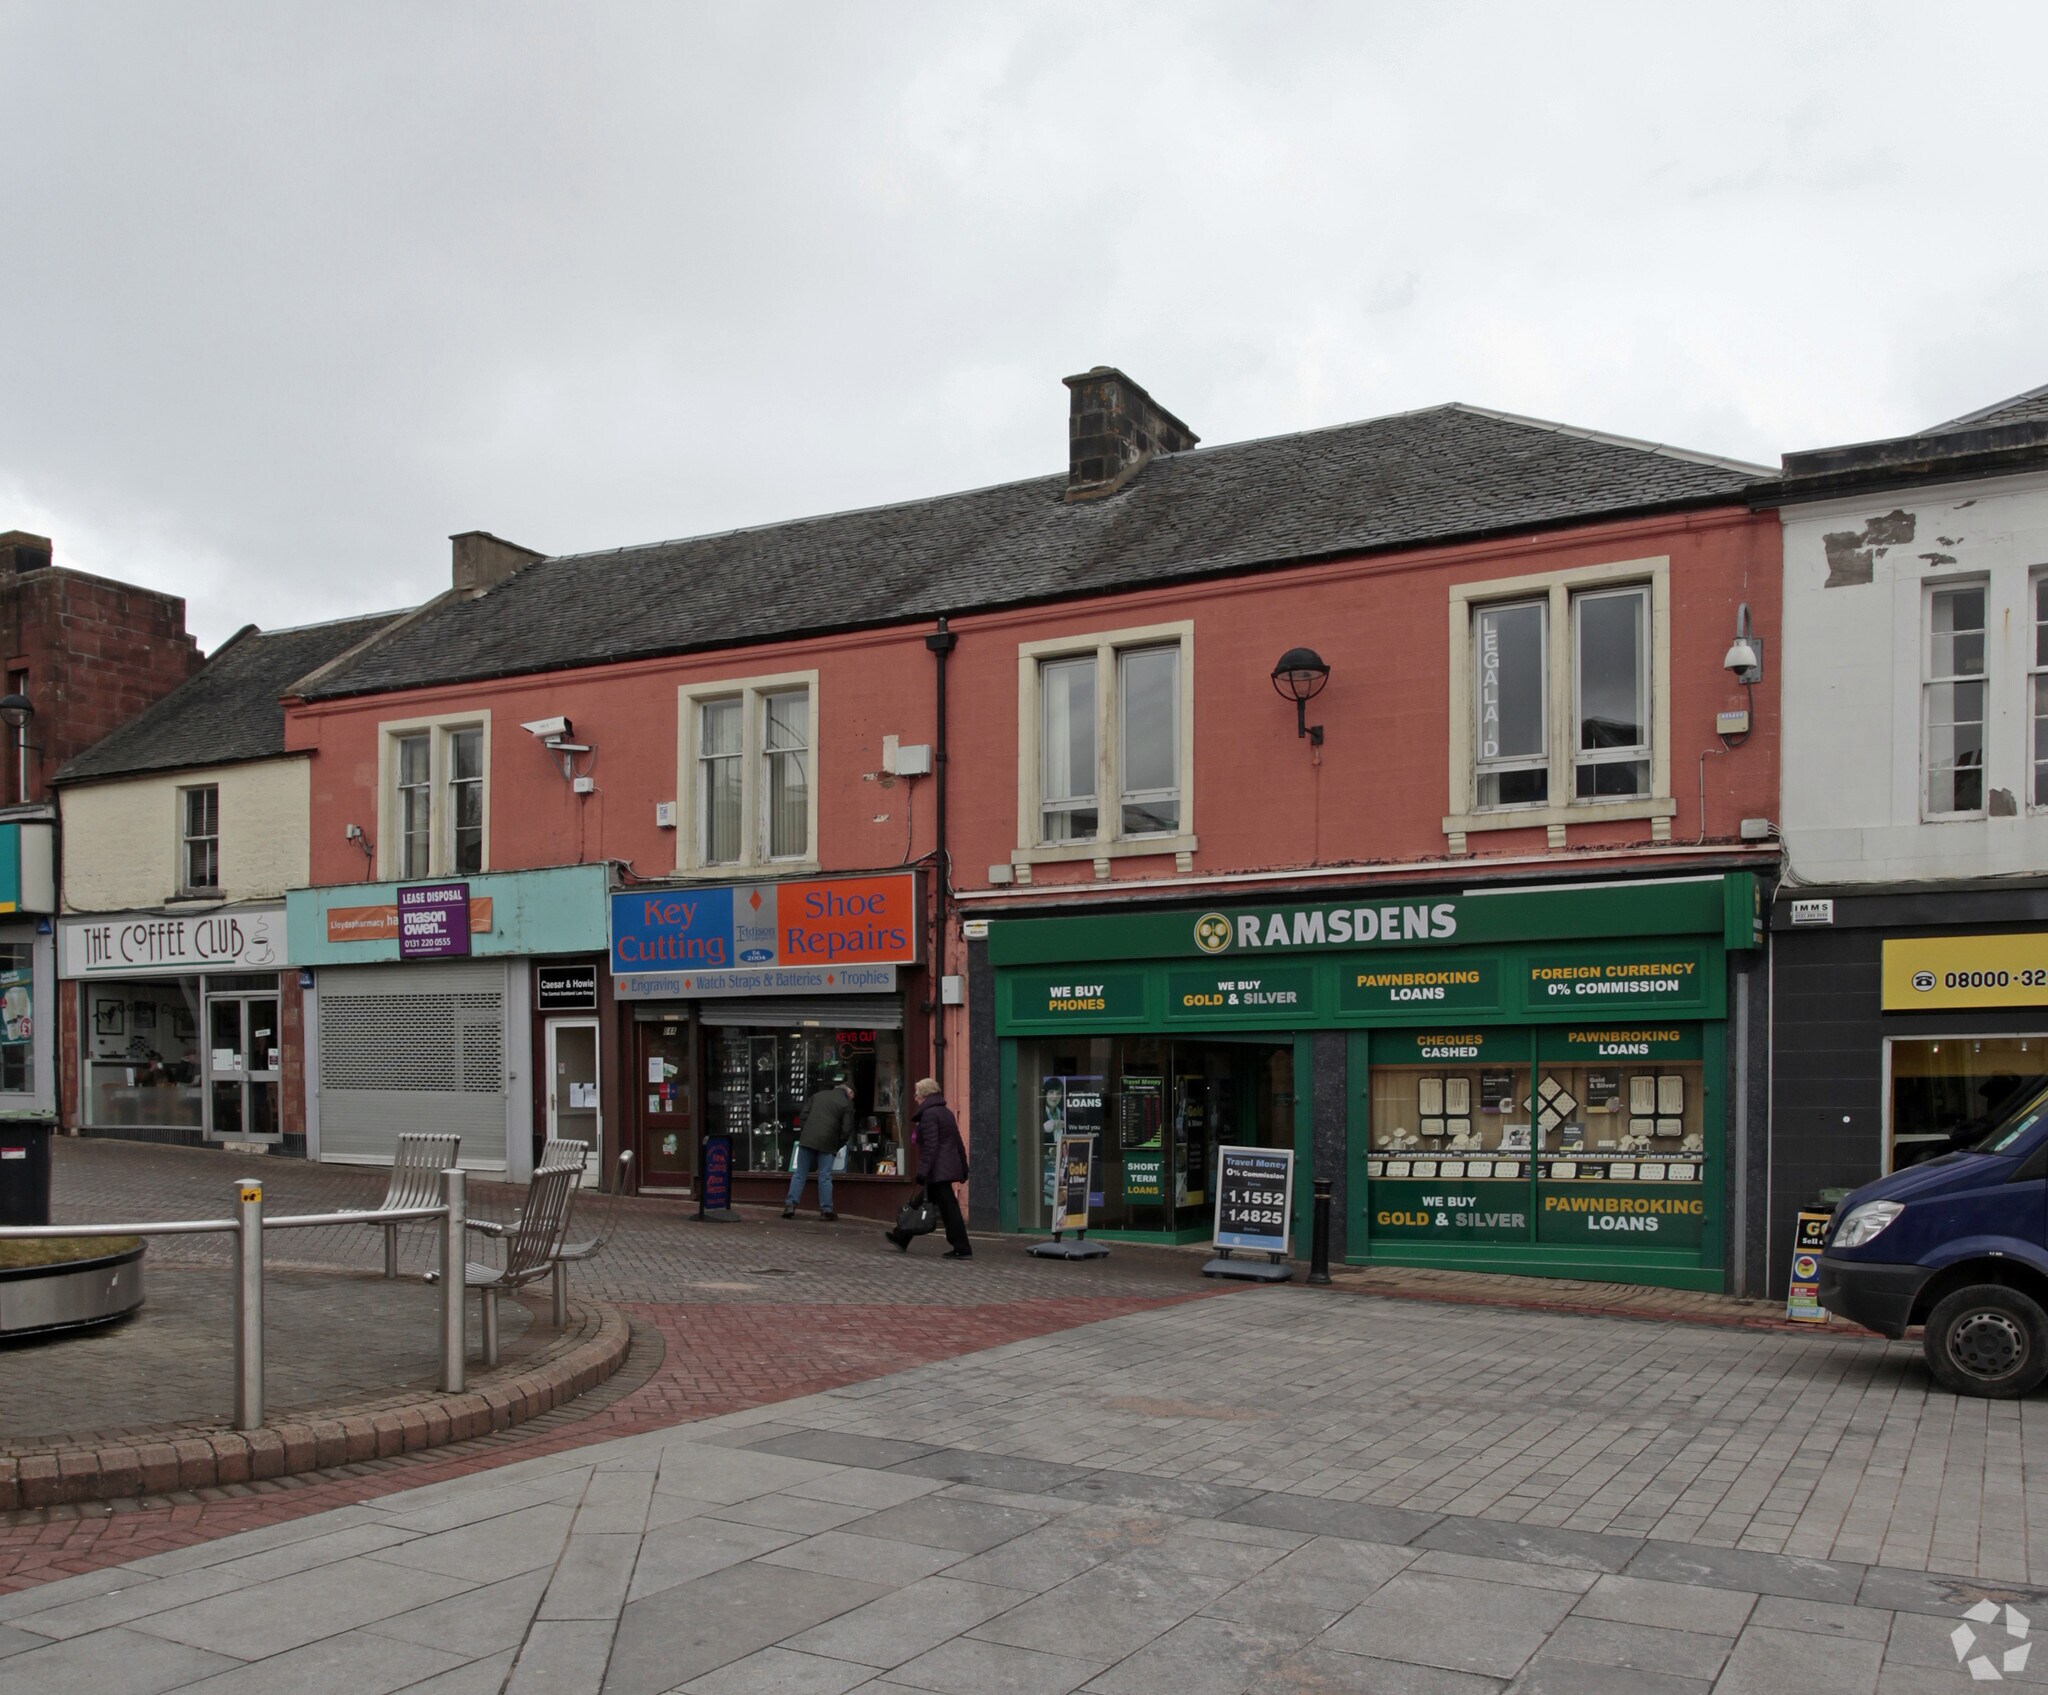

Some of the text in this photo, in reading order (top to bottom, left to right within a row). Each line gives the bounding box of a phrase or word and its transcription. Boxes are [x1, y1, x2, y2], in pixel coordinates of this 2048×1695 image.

[403, 889, 462, 904] LEASE DISPOSAL
[806, 891, 885, 919] Shoe
[404, 911, 446, 923] mason
[644, 899, 697, 930] Key
[1237, 903, 1457, 948] RAMSDENS
[84, 918, 244, 965] THE COFFEE CLUB
[405, 937, 451, 948] 0131 220 0555
[787, 923, 906, 959] Repairs
[617, 932, 726, 965] Cutting
[1532, 963, 1695, 980] FOREIGN CURRENCY
[2021, 970, 2048, 986] 32
[541, 979, 594, 989] Caesar & Howie
[631, 970, 889, 994] Engraving Watch Straps & Batteries Trophies
[1218, 981, 1261, 991] WE BUY
[1357, 971, 1479, 987] PAWNBROKING
[1050, 985, 1104, 998] WE BUY
[1390, 988, 1444, 1000] LOANS
[1548, 980, 1679, 995] 0% COMMISSION
[1049, 999, 1105, 1011] PHONES
[1183, 991, 1297, 1006] GOLD & SILVER
[1417, 1034, 1483, 1046] CHEQUES
[1568, 1031, 1680, 1043] PAWNBROKING
[1422, 1047, 1478, 1057] CASHED
[1599, 1044, 1649, 1055] LOANS
[1067, 1098, 1102, 1107] LOANS
[1070, 1162, 1087, 1175] Gold
[1127, 1163, 1159, 1171] SHORT
[1226, 1158, 1287, 1170] Travel Money
[1226, 1168, 1284, 1179] 0% Commission
[1127, 1186, 1159, 1195] LOANS
[1229, 1189, 1284, 1206] 1.1552
[1422, 1196, 1476, 1207] WE BUY
[1545, 1197, 1703, 1215] PAWNBROKING
[1229, 1209, 1283, 1225] 1.4825
[1377, 1212, 1525, 1228] GOLD & SILVER
[1588, 1215, 1658, 1231] LOANS
